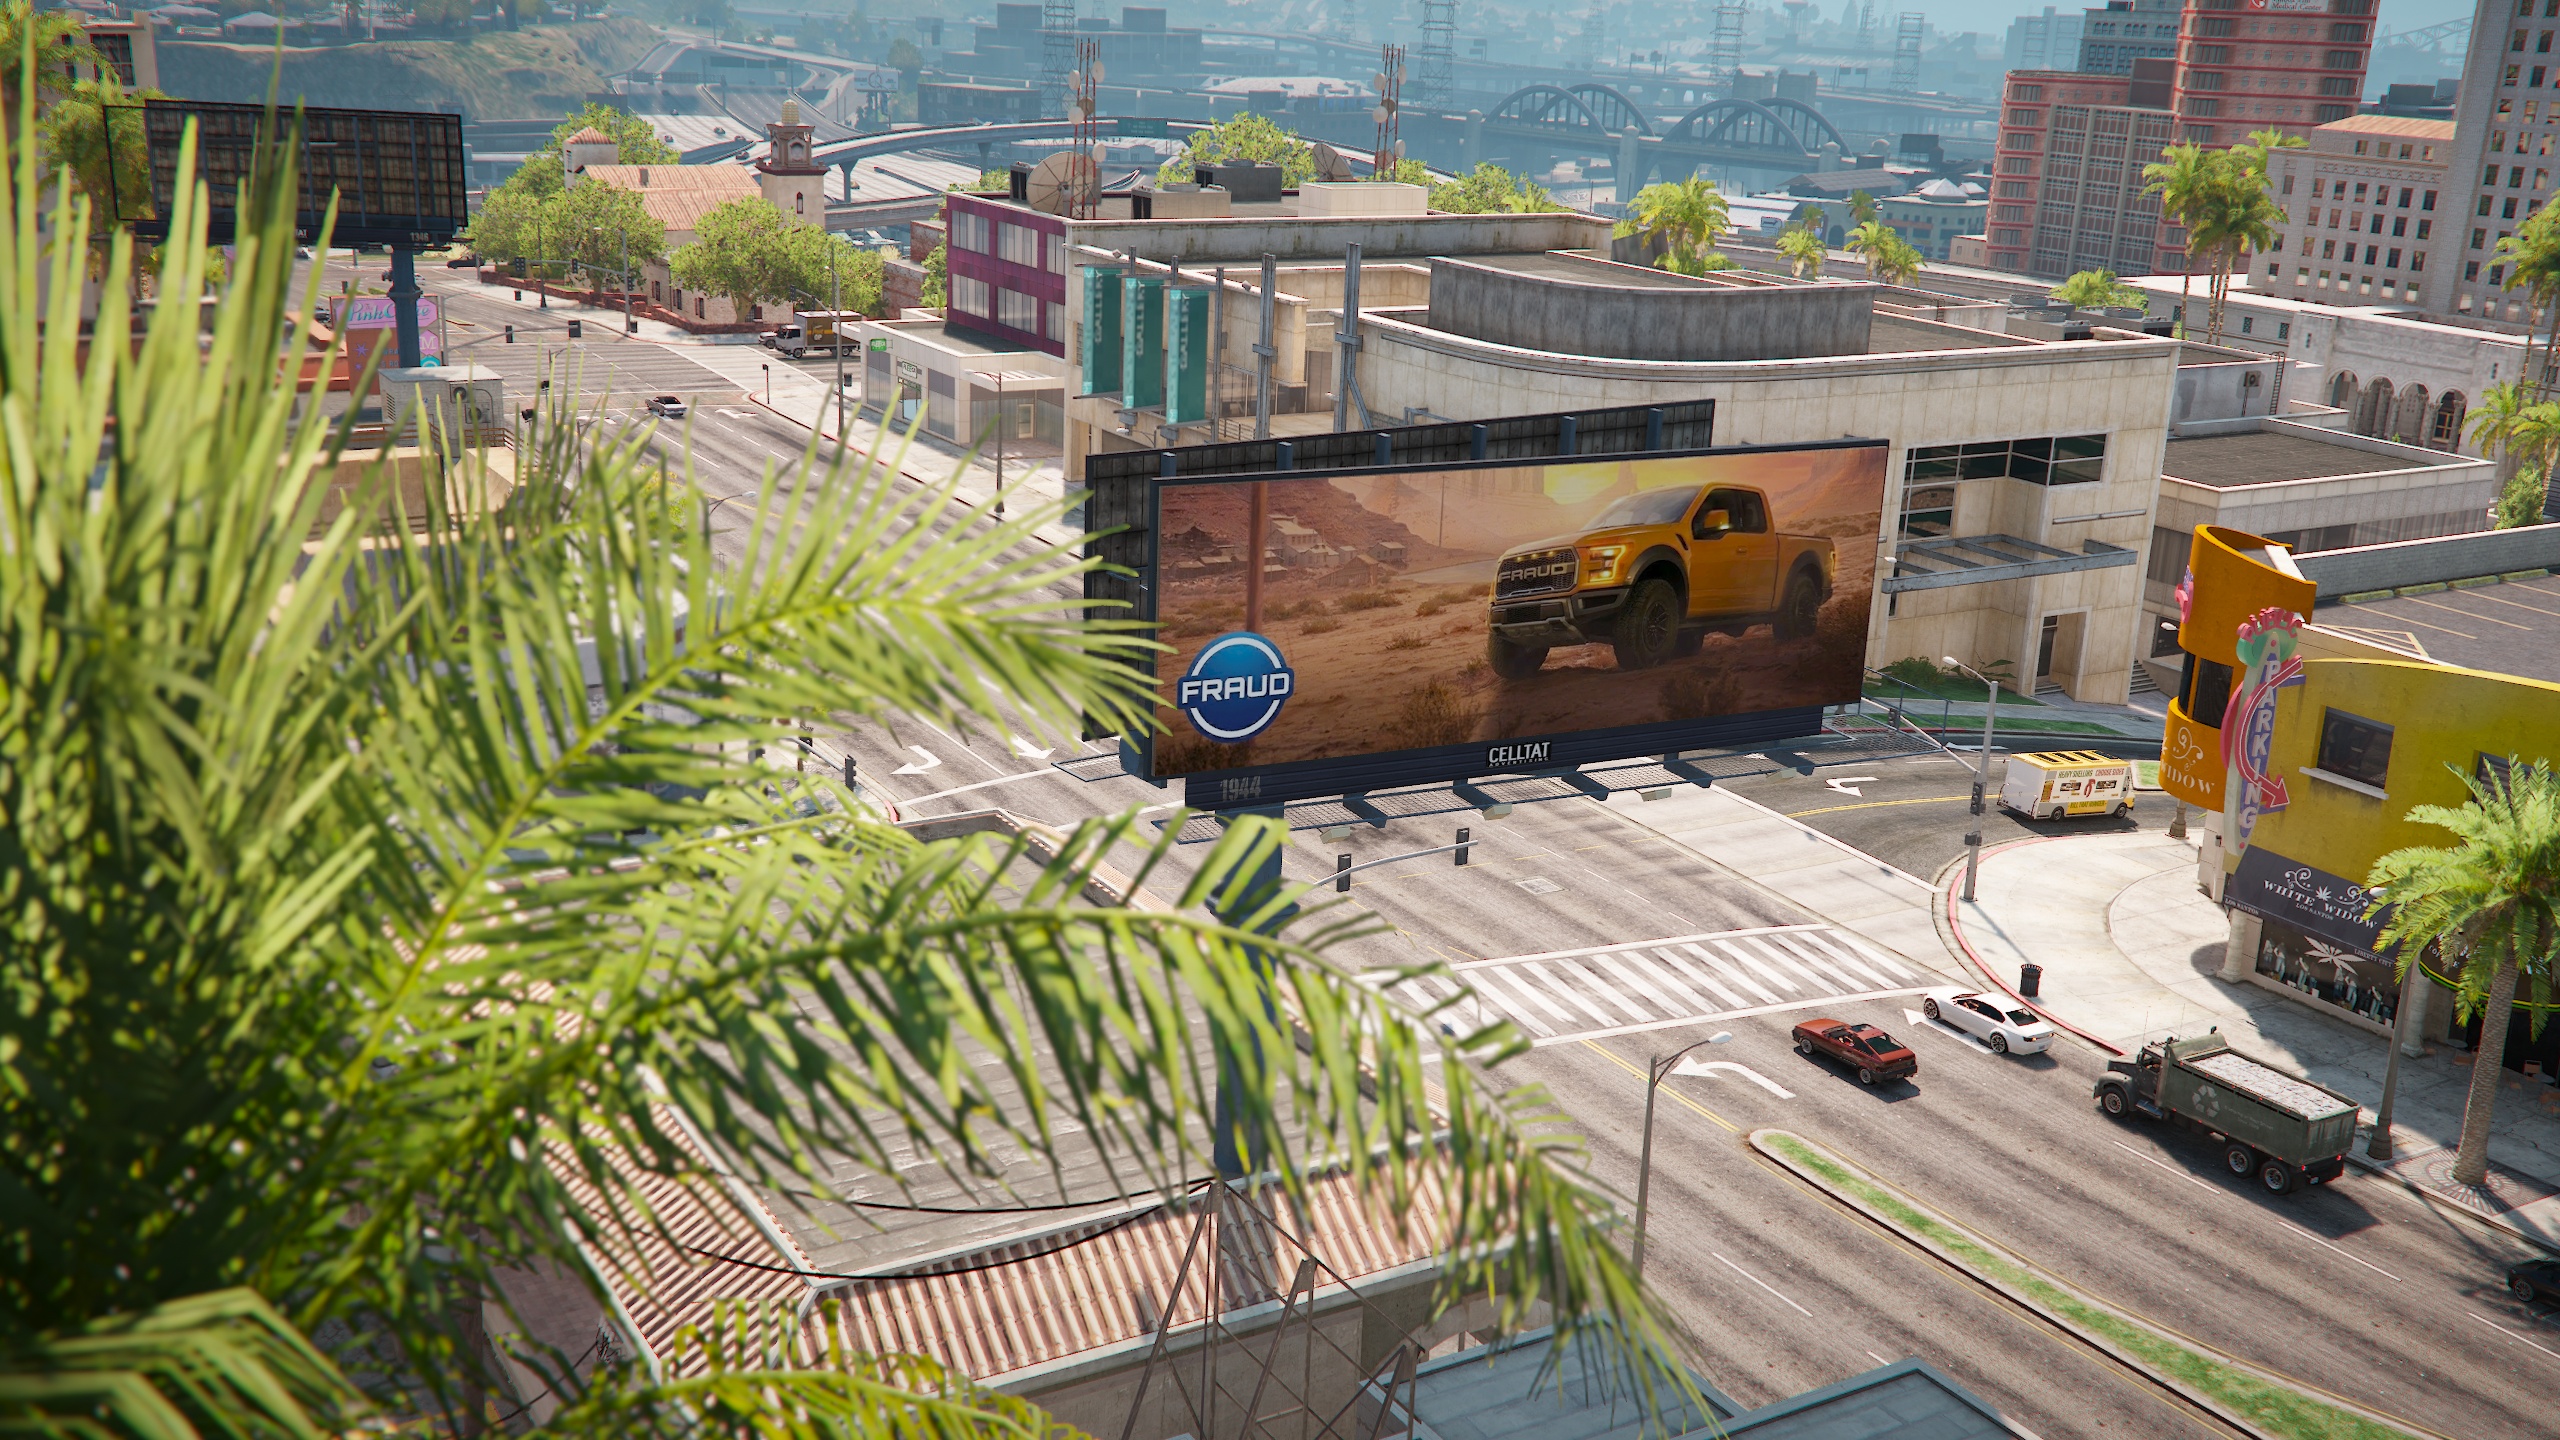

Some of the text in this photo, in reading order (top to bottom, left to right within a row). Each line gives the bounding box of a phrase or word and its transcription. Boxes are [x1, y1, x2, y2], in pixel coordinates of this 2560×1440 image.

[1498, 563, 1568, 583] FRAUD
[2237, 606, 2303, 644] PUBLIC
[1182, 672, 1290, 704] FRAUD
[1489, 742, 1551, 763] CELLTAT
[2238, 660, 2281, 829] PARKING
[1488, 757, 1549, 768] ADVERTISING
[1220, 775, 1261, 801] 1944
[2264, 880, 2378, 929] WHITE WIDOW
[2296, 903, 2334, 921] LOS SANTOS
[2354, 949, 2378, 963] LIBERTY
